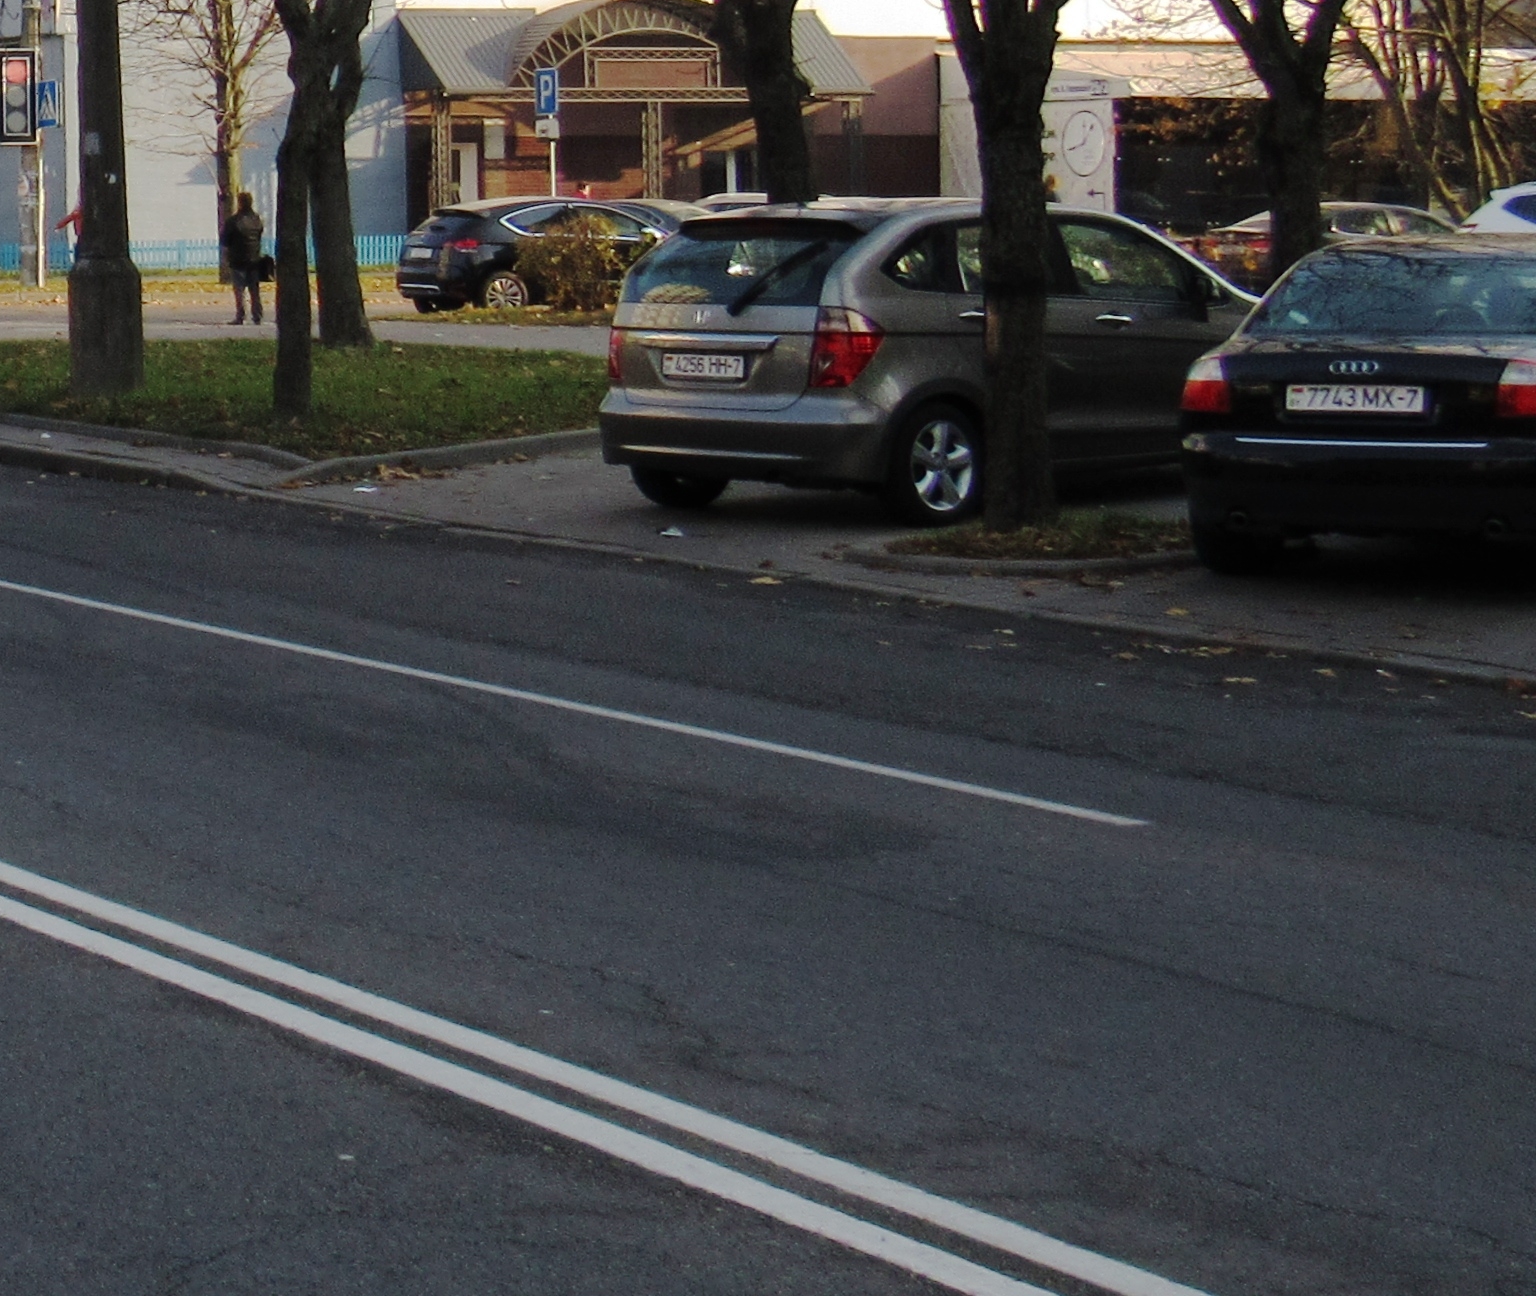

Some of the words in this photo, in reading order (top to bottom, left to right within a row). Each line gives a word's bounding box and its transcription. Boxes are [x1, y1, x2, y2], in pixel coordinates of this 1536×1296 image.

[539, 74, 553, 110] P
[1307, 387, 1357, 407] 7743
[1362, 387, 1419, 409] MX-7
